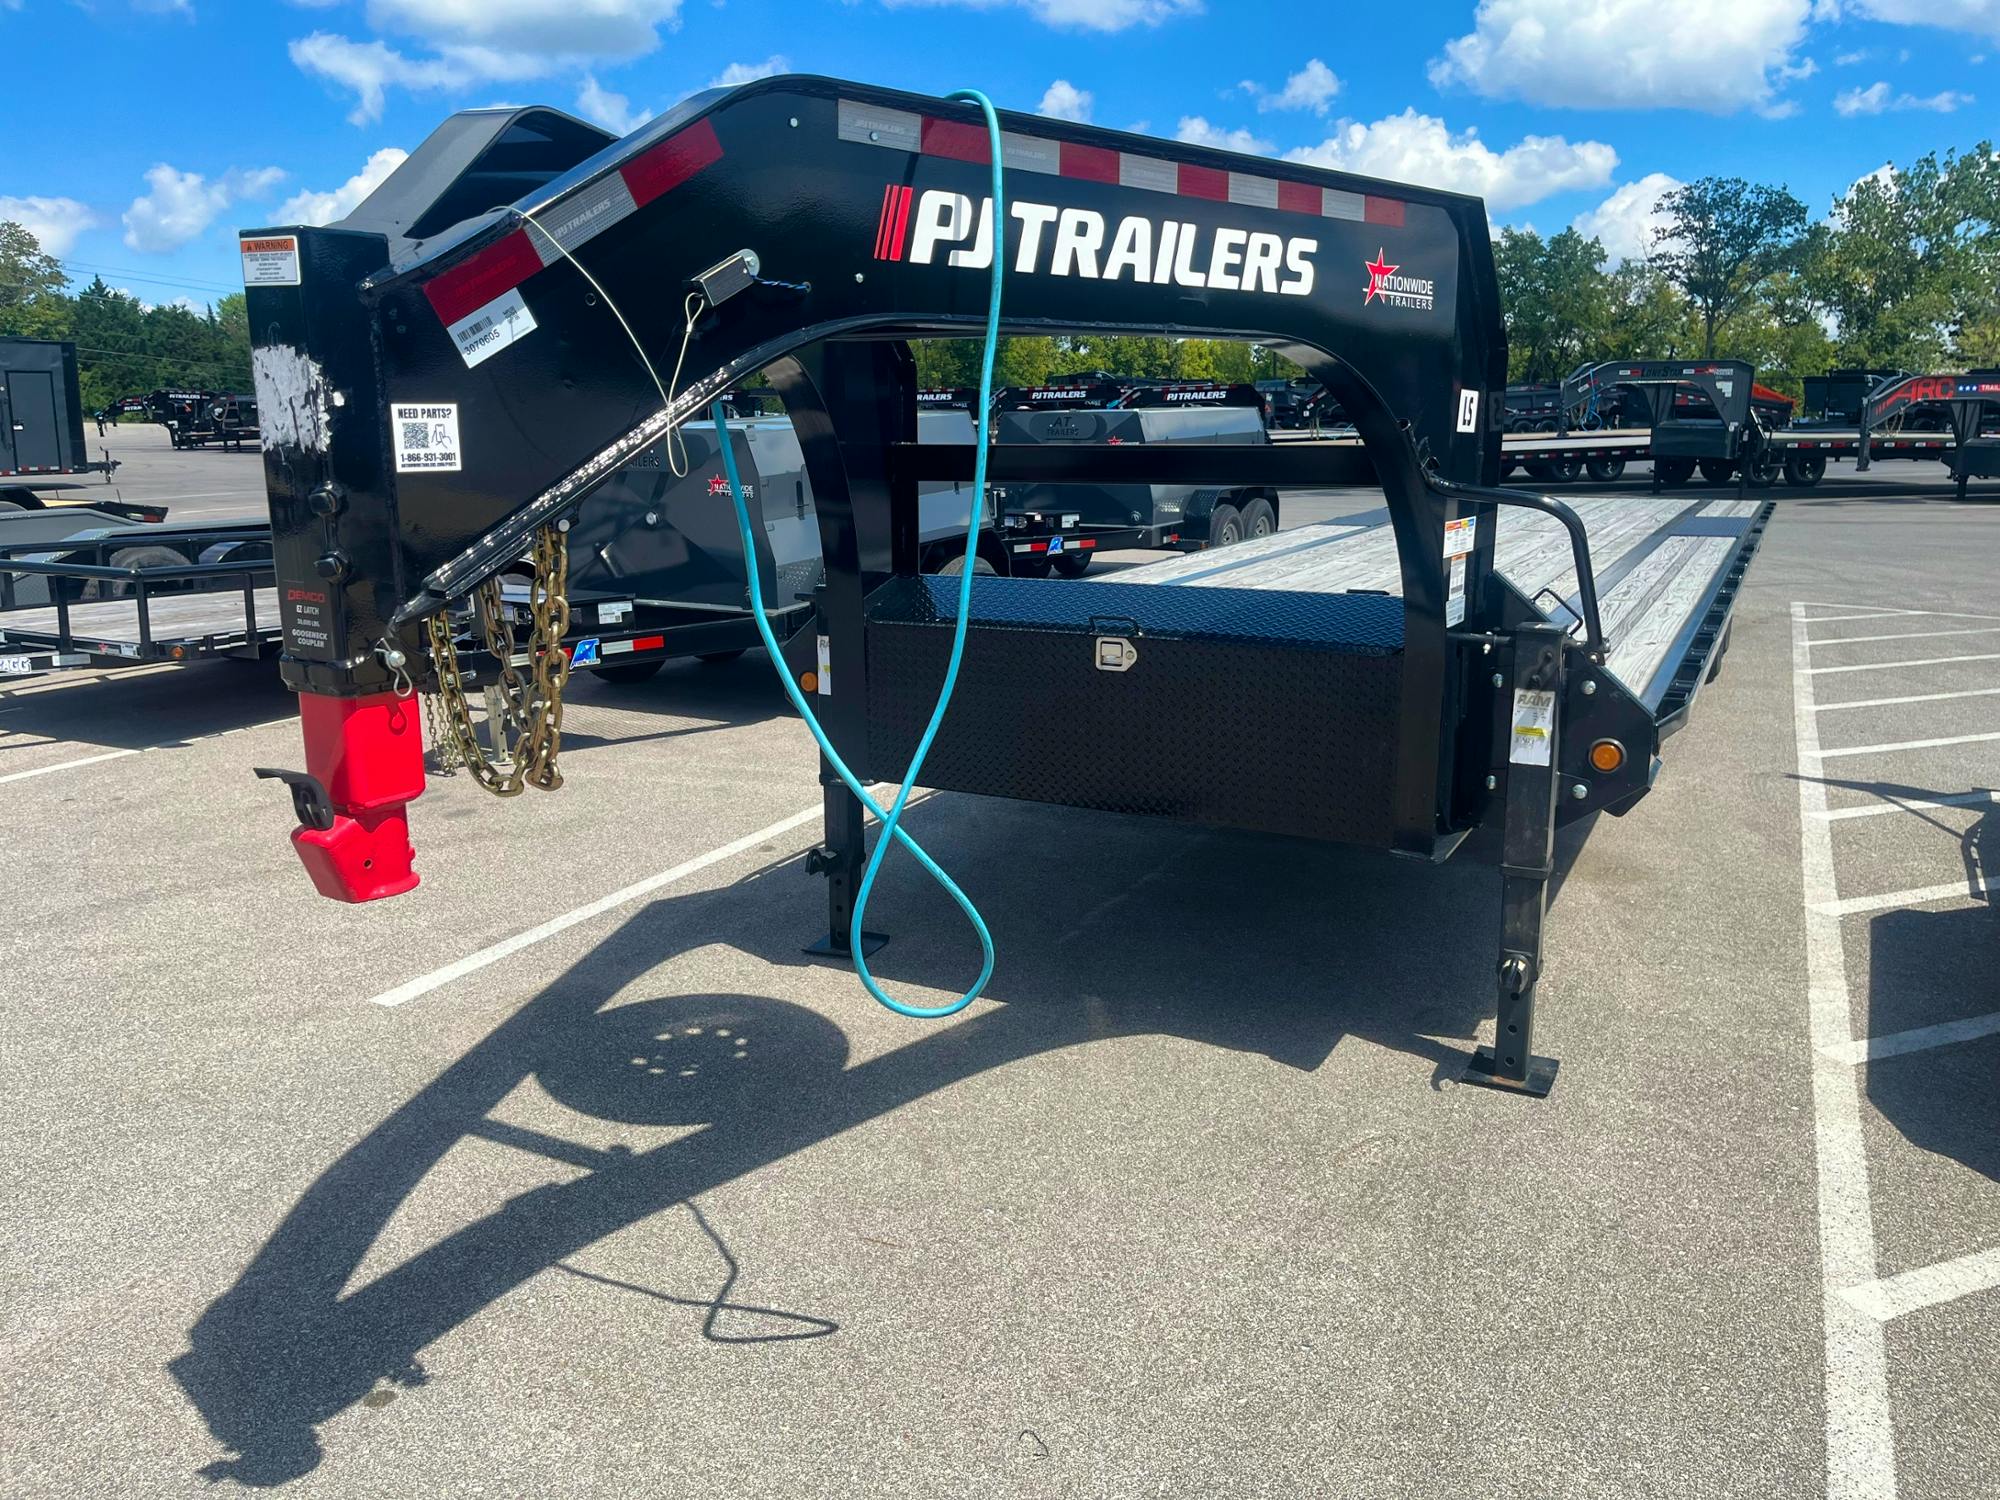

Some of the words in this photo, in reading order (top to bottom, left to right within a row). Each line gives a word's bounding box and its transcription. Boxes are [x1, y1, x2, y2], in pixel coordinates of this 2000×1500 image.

[254, 240, 289, 250] WARNING
[908, 189, 993, 269] PJ
[1011, 200, 1318, 296] TRAILERS
[1374, 272, 1434, 295] NATIONWIDE
[1389, 295, 1433, 311] TRAILERS
[463, 328, 501, 356] 3070605
[917, 393, 953, 401] RAILERS
[1043, 390, 1087, 399] TRAILERS
[1179, 390, 1227, 400] TRAILERS
[398, 408, 418, 419] NEED
[421, 407, 452, 419] PARTS?
[288, 589, 325, 603] DEMCO
[291, 628, 328, 640] GOOSENECK
[297, 637, 325, 648] COUPLER
[1518, 694, 1552, 707] RAM
